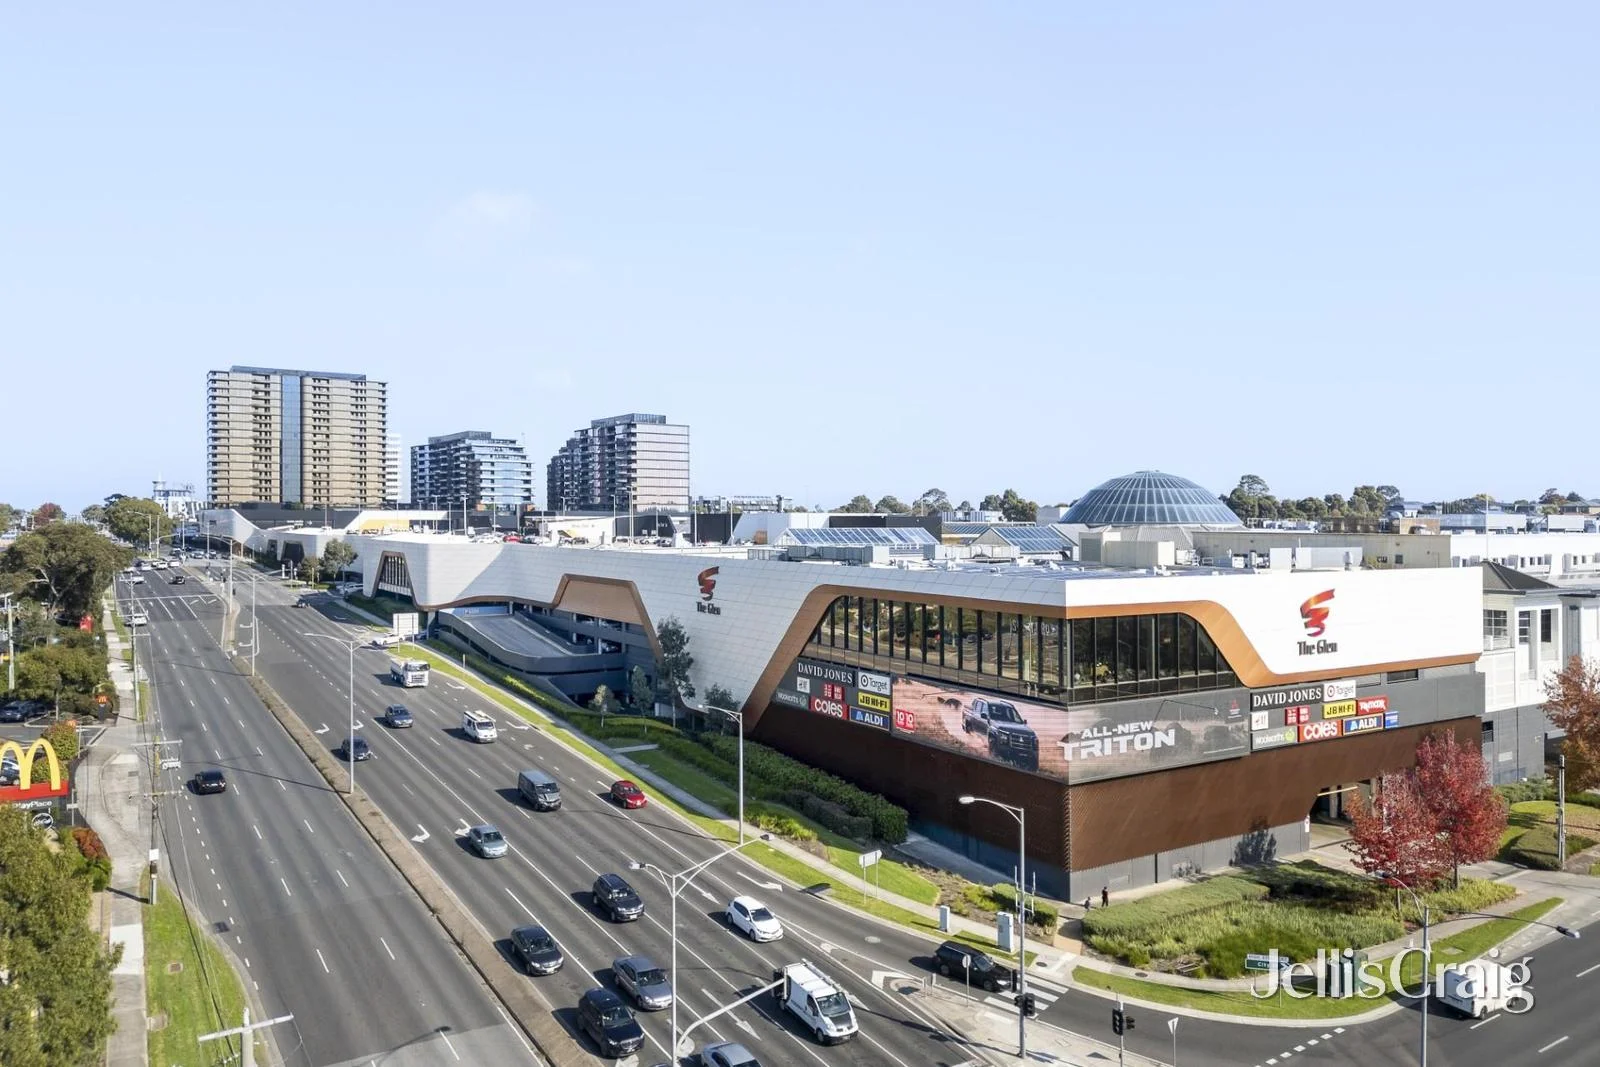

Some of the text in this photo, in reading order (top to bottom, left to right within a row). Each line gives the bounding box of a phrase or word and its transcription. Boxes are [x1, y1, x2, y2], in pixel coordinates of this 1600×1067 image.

[1297, 639, 1338, 656] The Glen
[798, 662, 853, 684] DAVID JONES
[868, 677, 888, 691] Target
[860, 695, 888, 709] JB HI-FI
[1253, 688, 1322, 707] DAVID JONES
[814, 698, 844, 718] coles
[1326, 704, 1354, 715] JB HI-FI
[864, 712, 884, 727] ALDI
[1358, 716, 1377, 730] ALDI
[1081, 720, 1154, 740] ALL-NEW
[1303, 721, 1338, 740] coles
[1057, 728, 1176, 762] TRITON
